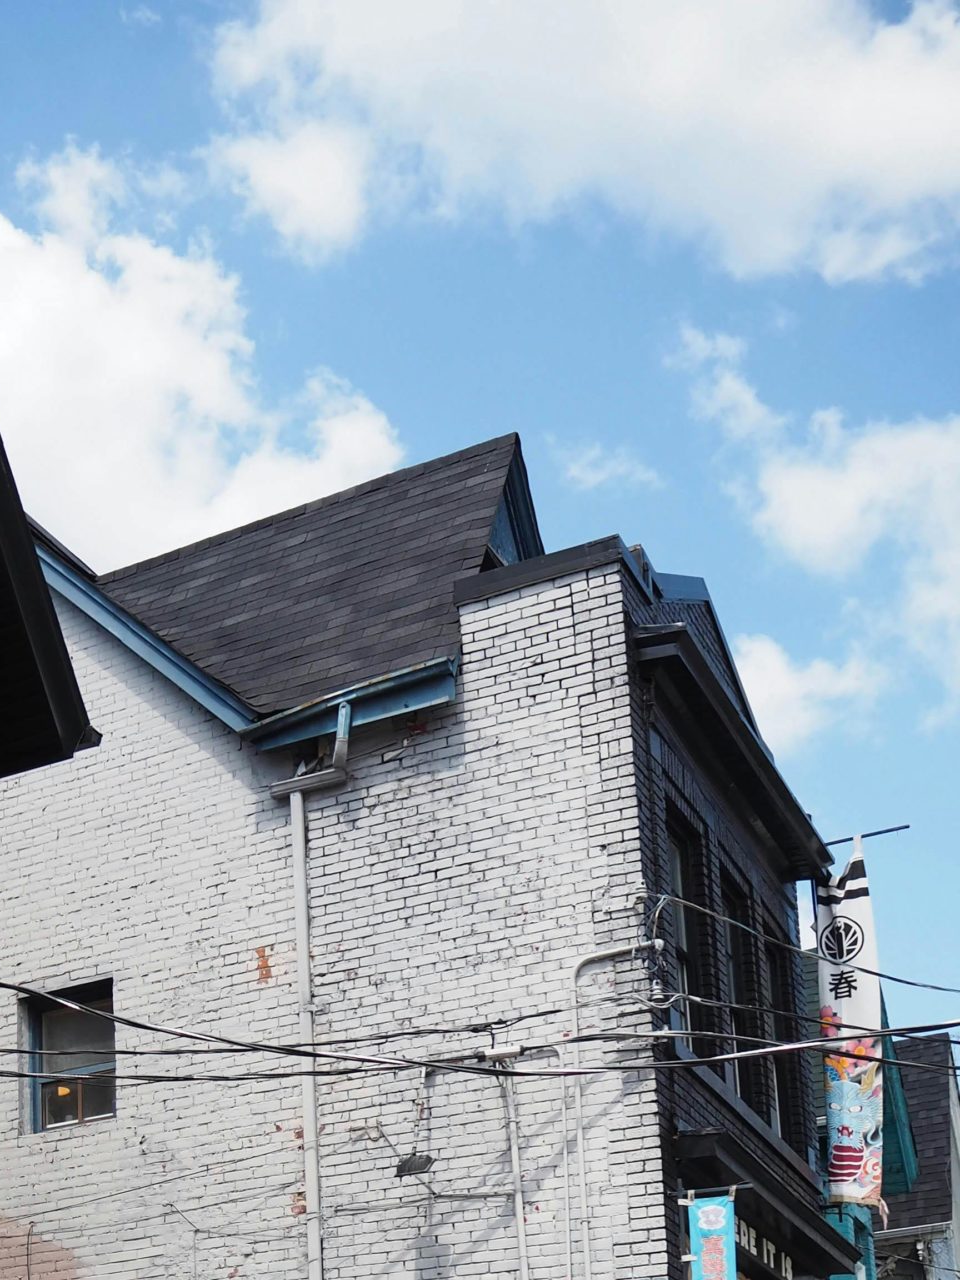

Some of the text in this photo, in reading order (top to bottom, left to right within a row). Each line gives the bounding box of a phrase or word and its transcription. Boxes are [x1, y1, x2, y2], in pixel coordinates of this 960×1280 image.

[828, 970, 858, 1000] 春
[734, 1215, 758, 1257] ERE
[763, 1237, 776, 1269] IT
